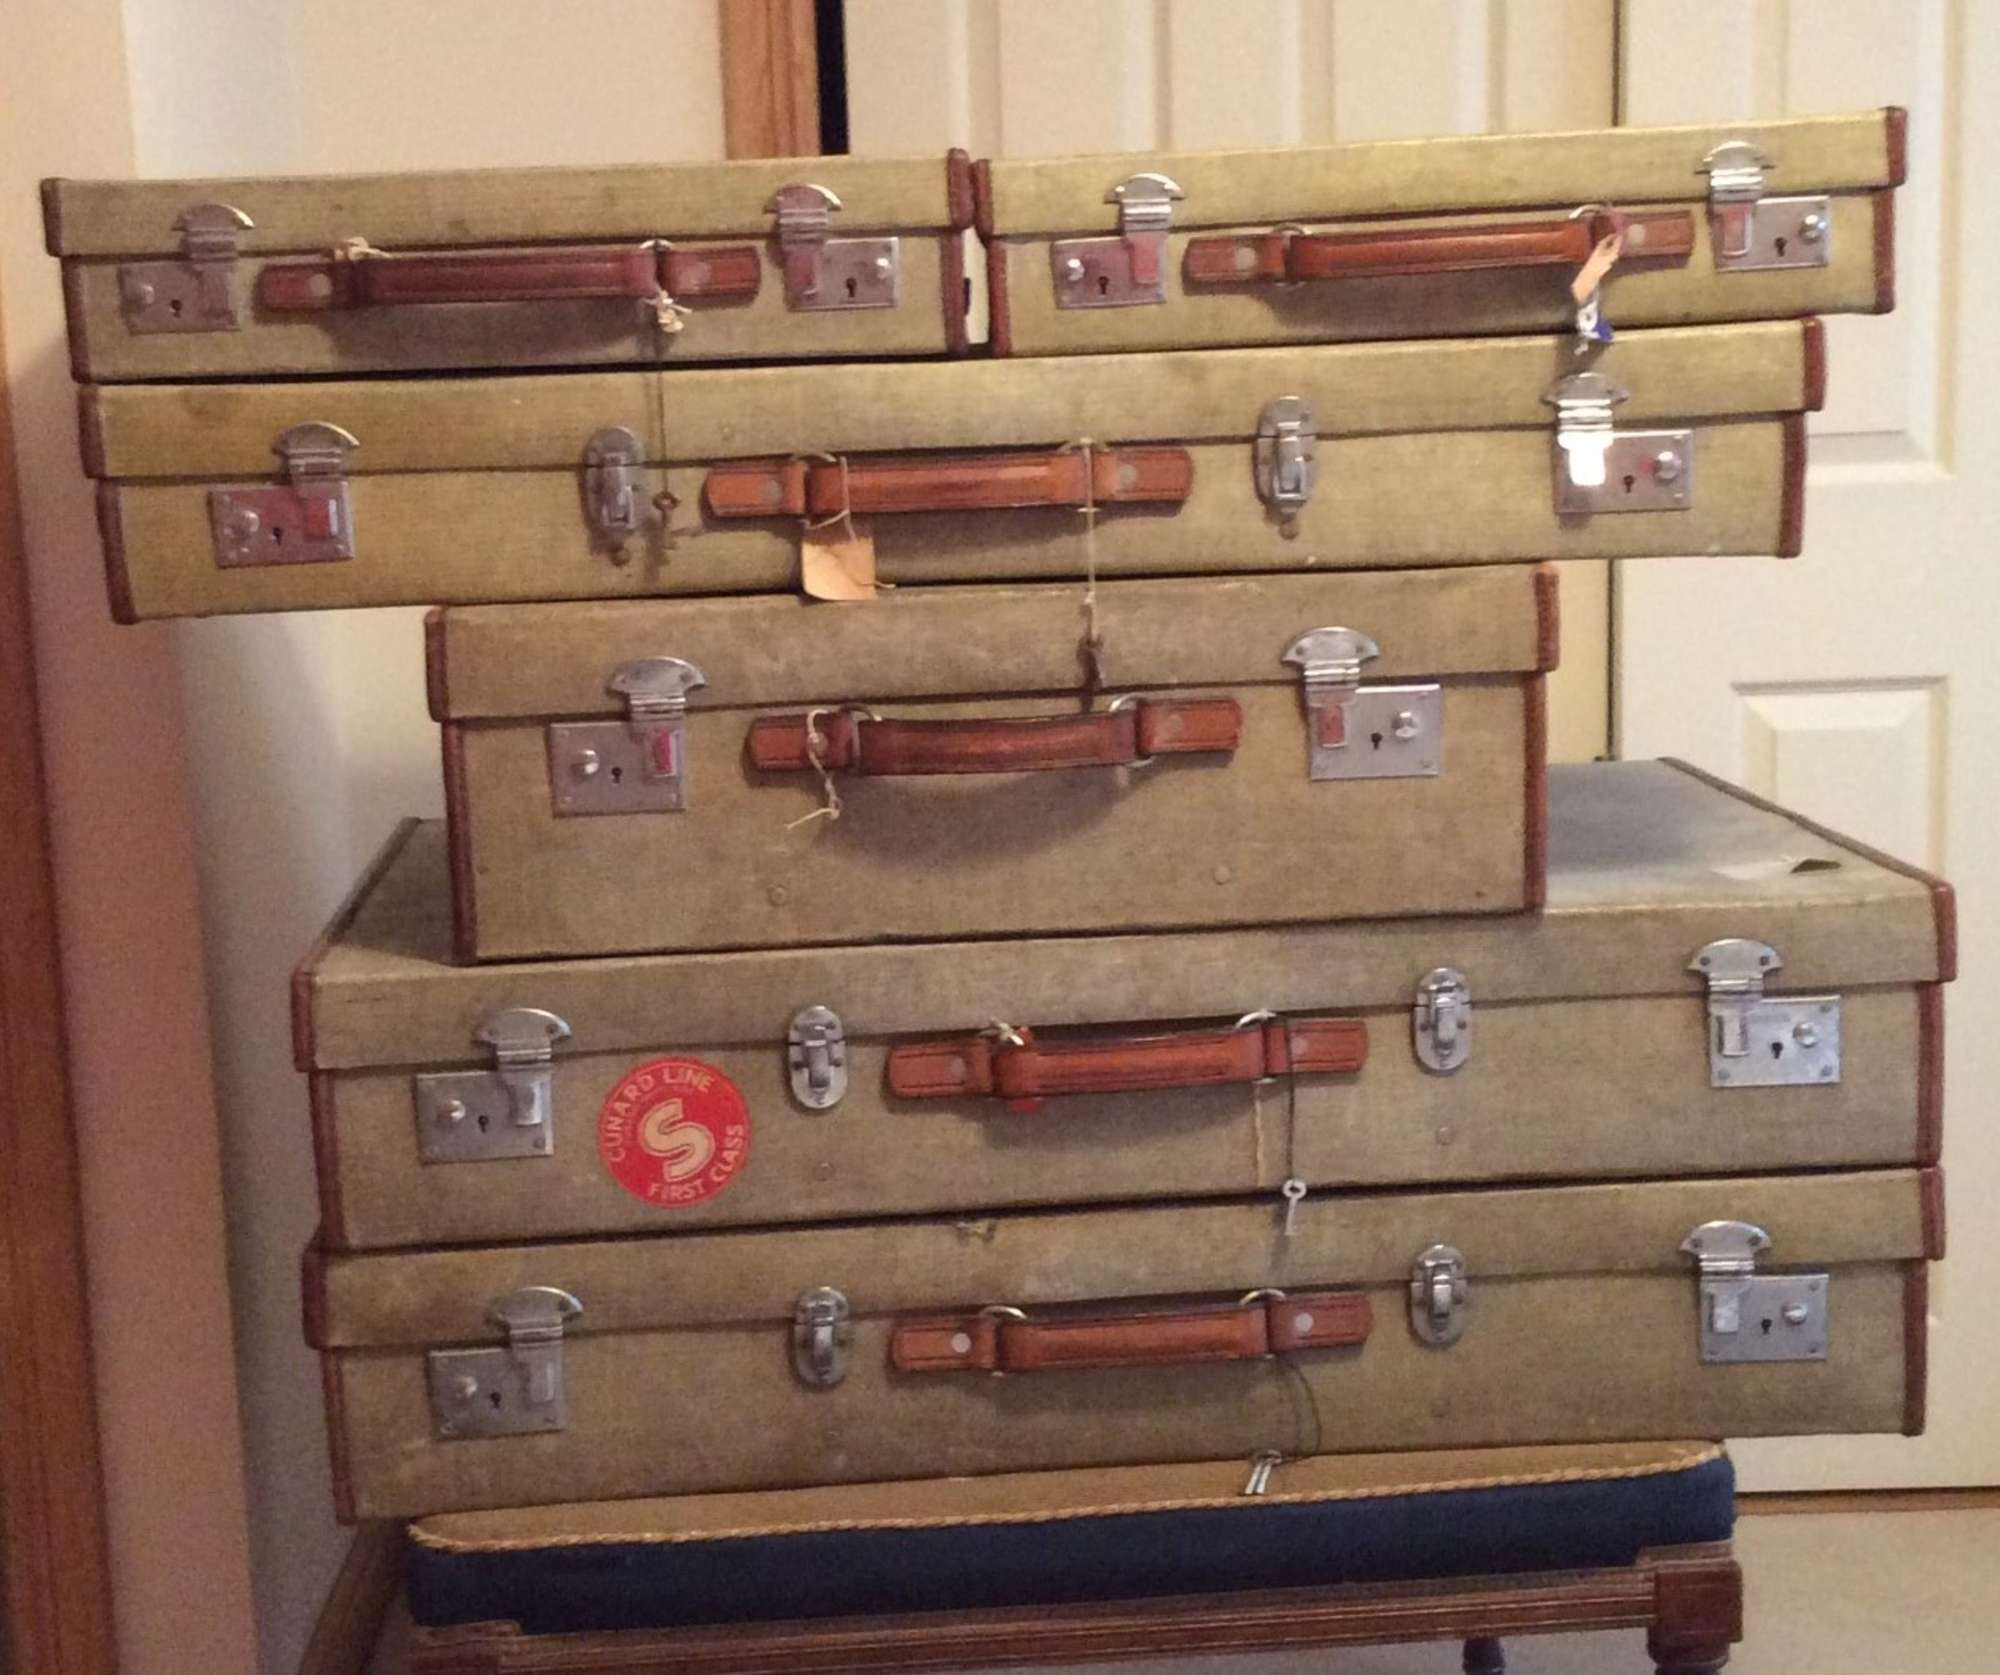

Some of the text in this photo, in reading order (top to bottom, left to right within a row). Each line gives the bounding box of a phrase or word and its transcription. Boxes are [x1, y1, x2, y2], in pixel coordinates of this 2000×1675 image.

[606, 1067, 715, 1162] CUNARD LINE
[648, 1124, 745, 1200] FIRST CLASS
